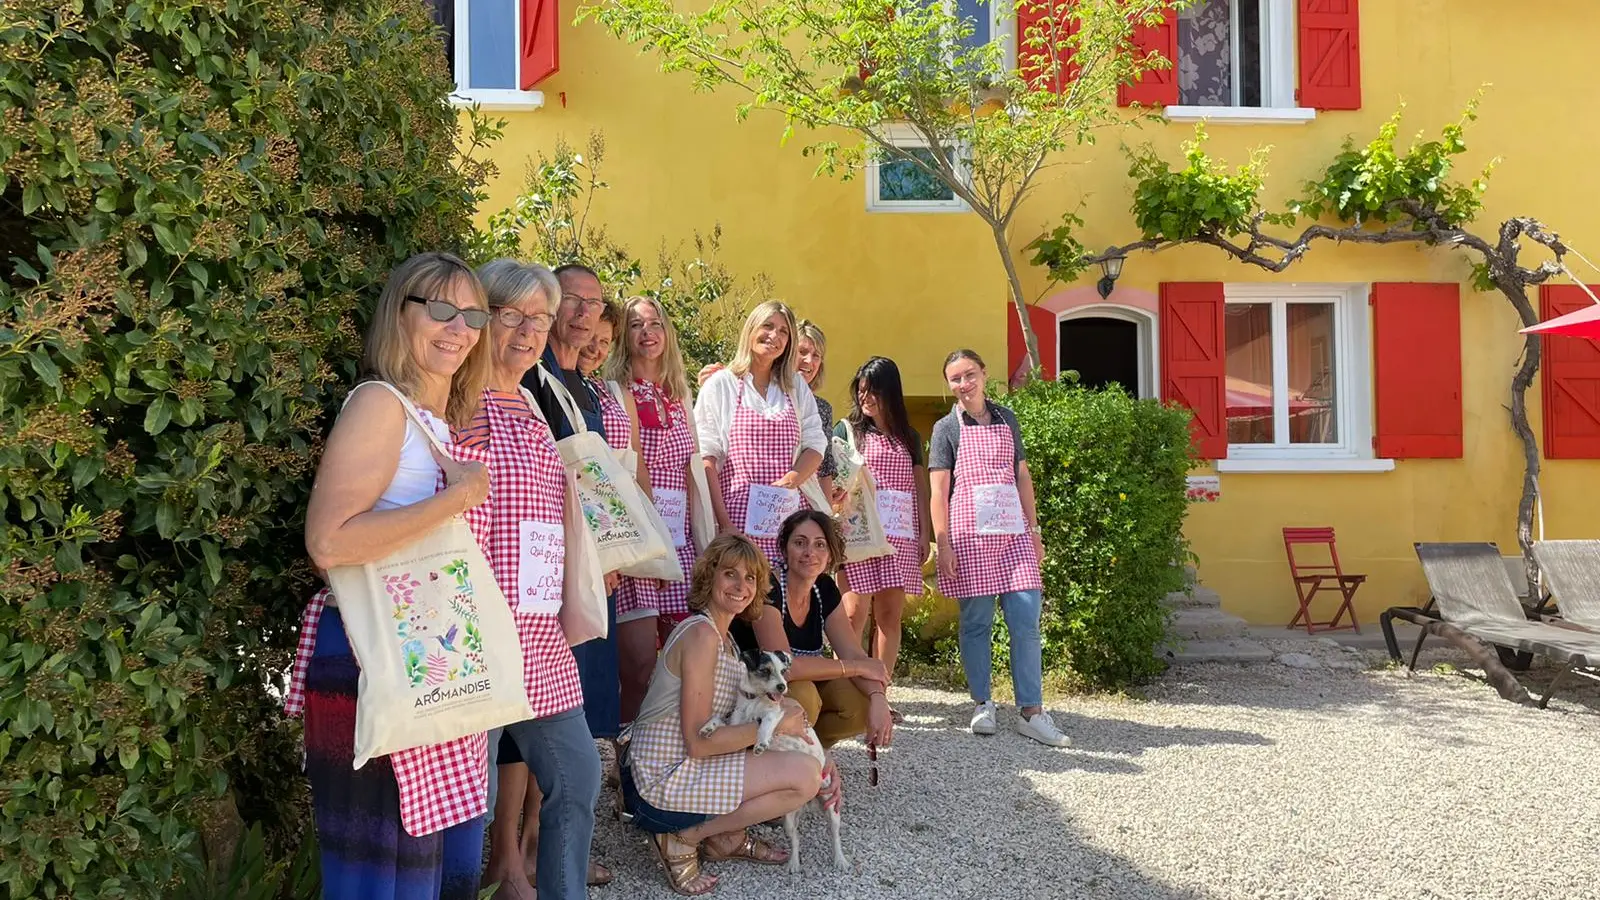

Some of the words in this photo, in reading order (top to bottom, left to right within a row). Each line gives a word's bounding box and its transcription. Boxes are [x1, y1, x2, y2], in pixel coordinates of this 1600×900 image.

[529, 530, 546, 542] Des
[529, 545, 544, 558] Qui
[526, 585, 538, 596] du
[414, 678, 492, 709] AROMANDISE
